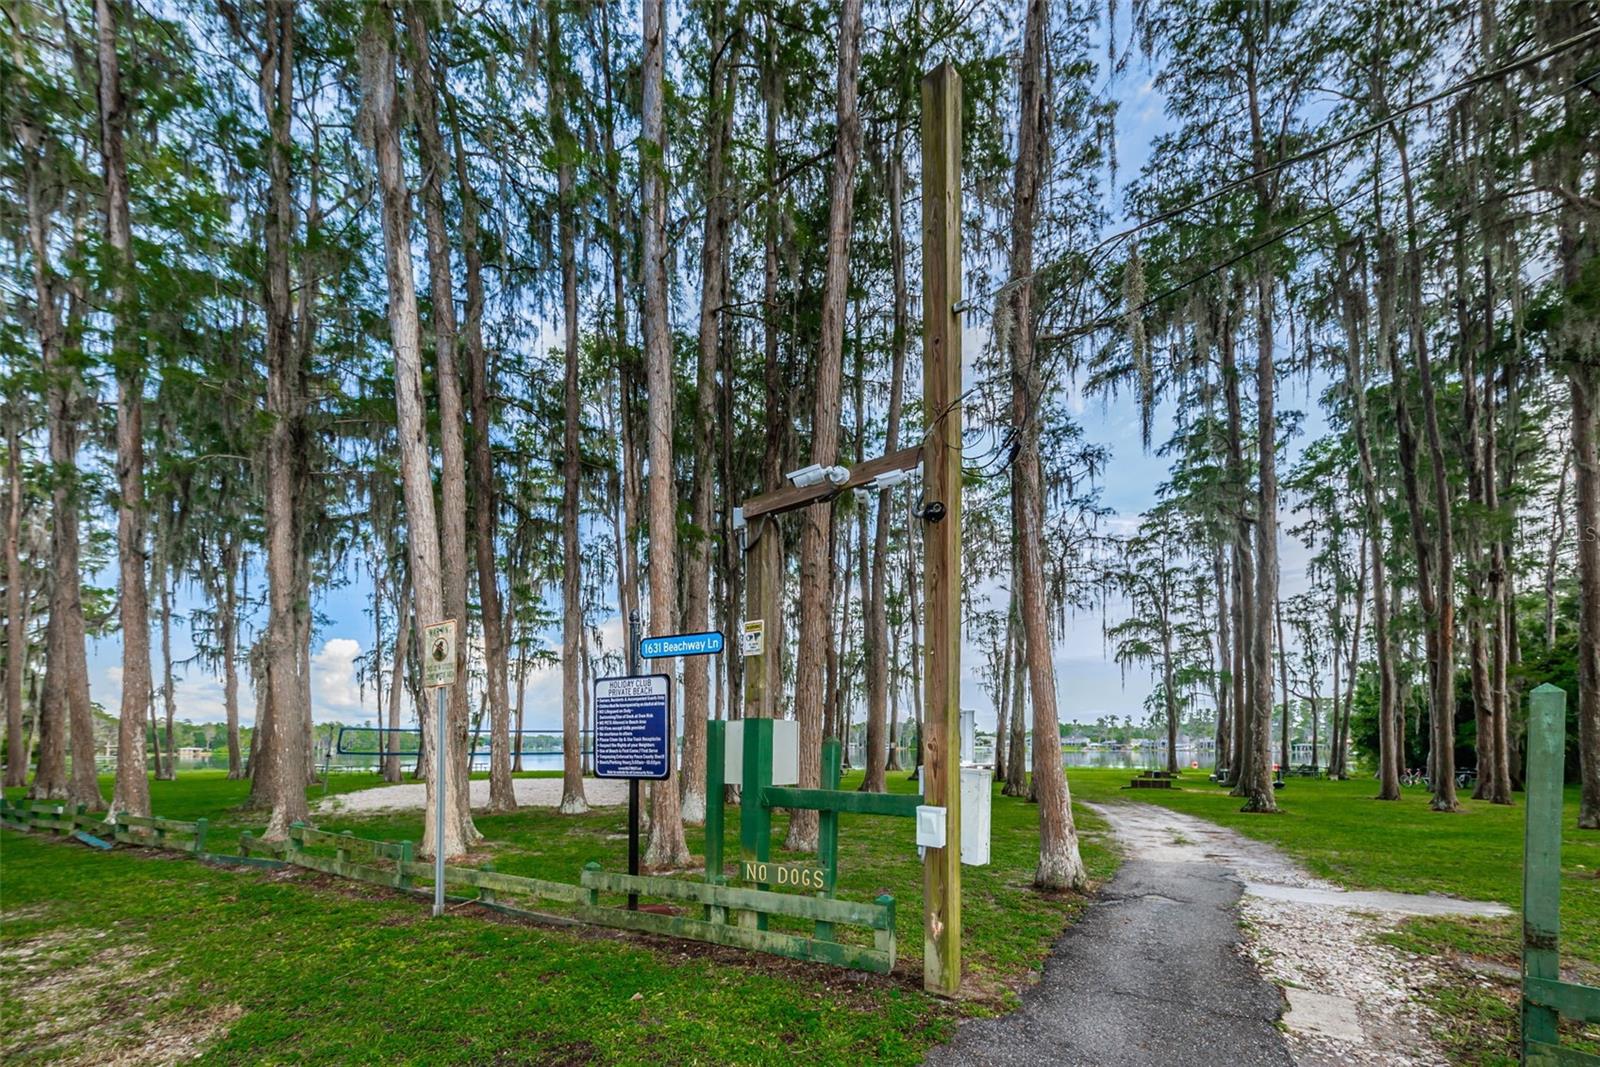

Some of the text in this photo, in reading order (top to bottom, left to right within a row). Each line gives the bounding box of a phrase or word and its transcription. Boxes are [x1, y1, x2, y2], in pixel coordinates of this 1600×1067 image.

[645, 638, 719, 654] 1631 Beachway Ln
[610, 679, 652, 689] HOLIDAY CLUB
[608, 687, 653, 697] PRIVATE BEACH
[746, 863, 824, 889] NO DOGS
